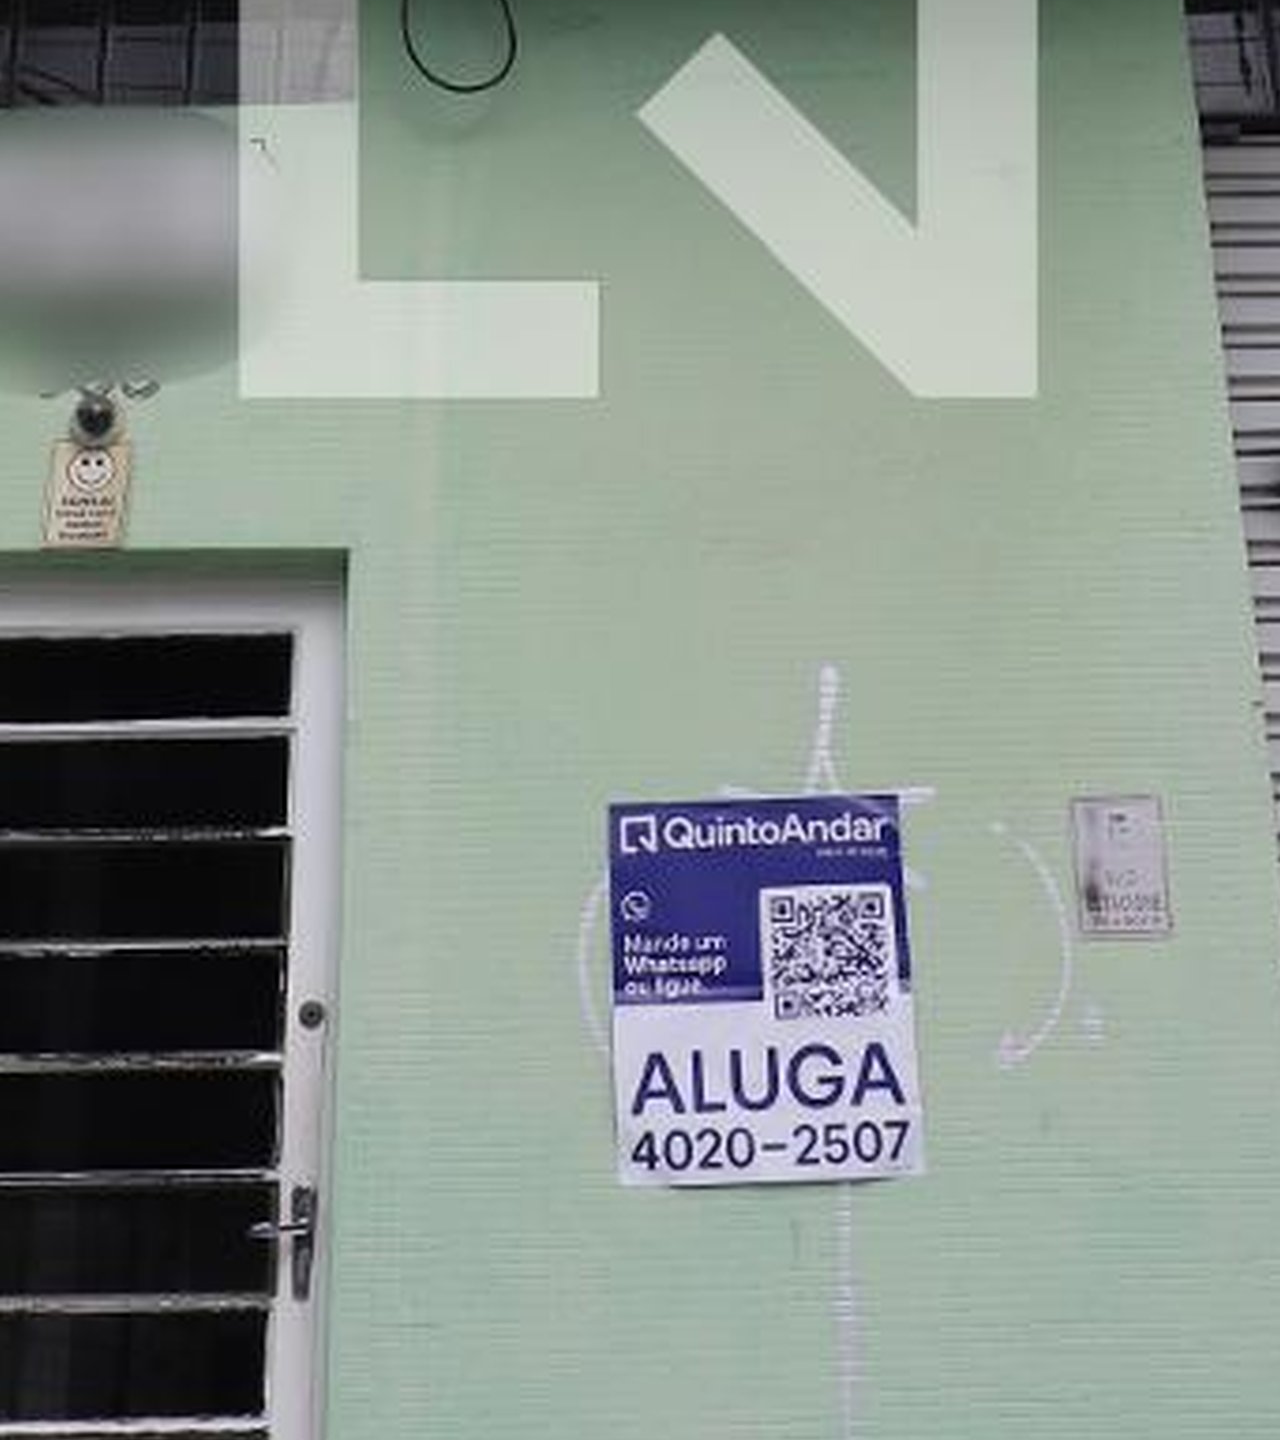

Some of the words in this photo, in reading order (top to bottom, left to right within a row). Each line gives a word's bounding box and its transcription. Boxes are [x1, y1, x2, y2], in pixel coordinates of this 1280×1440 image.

[663, 813, 888, 849] QuintoAndar
[631, 1042, 906, 1115] ALUGA
[631, 1120, 911, 1171] 4020-2507
